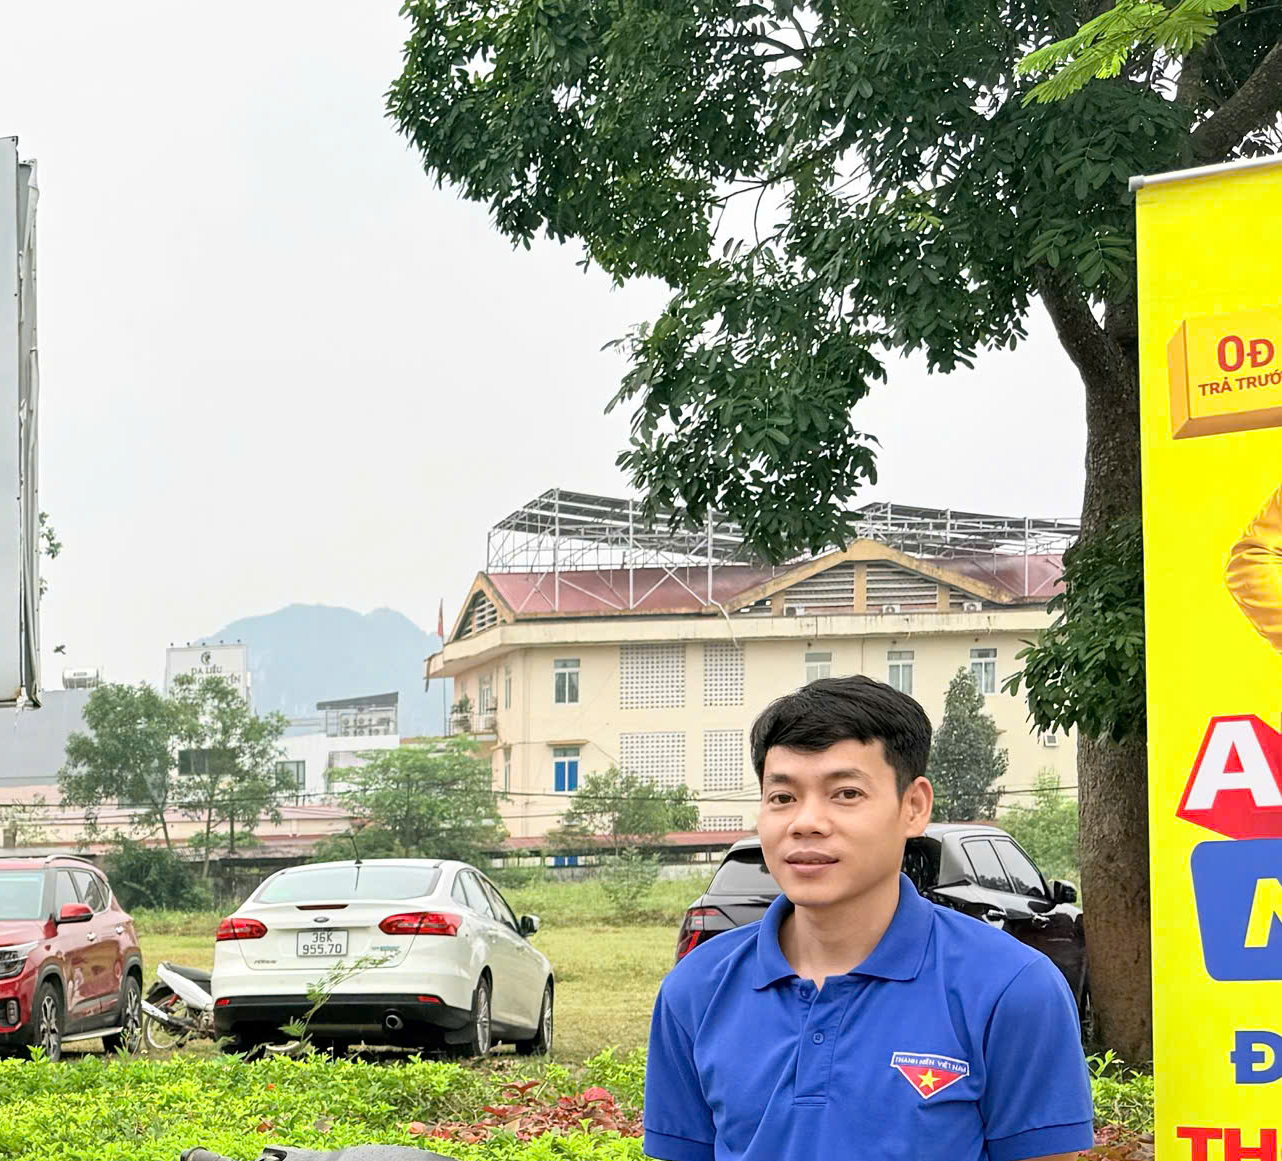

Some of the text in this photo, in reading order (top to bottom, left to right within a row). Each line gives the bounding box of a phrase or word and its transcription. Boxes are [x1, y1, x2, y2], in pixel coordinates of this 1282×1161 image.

[1198, 376, 1232, 396] TRẢ
[312, 931, 333, 942] 36K
[302, 943, 343, 955] 955.70
